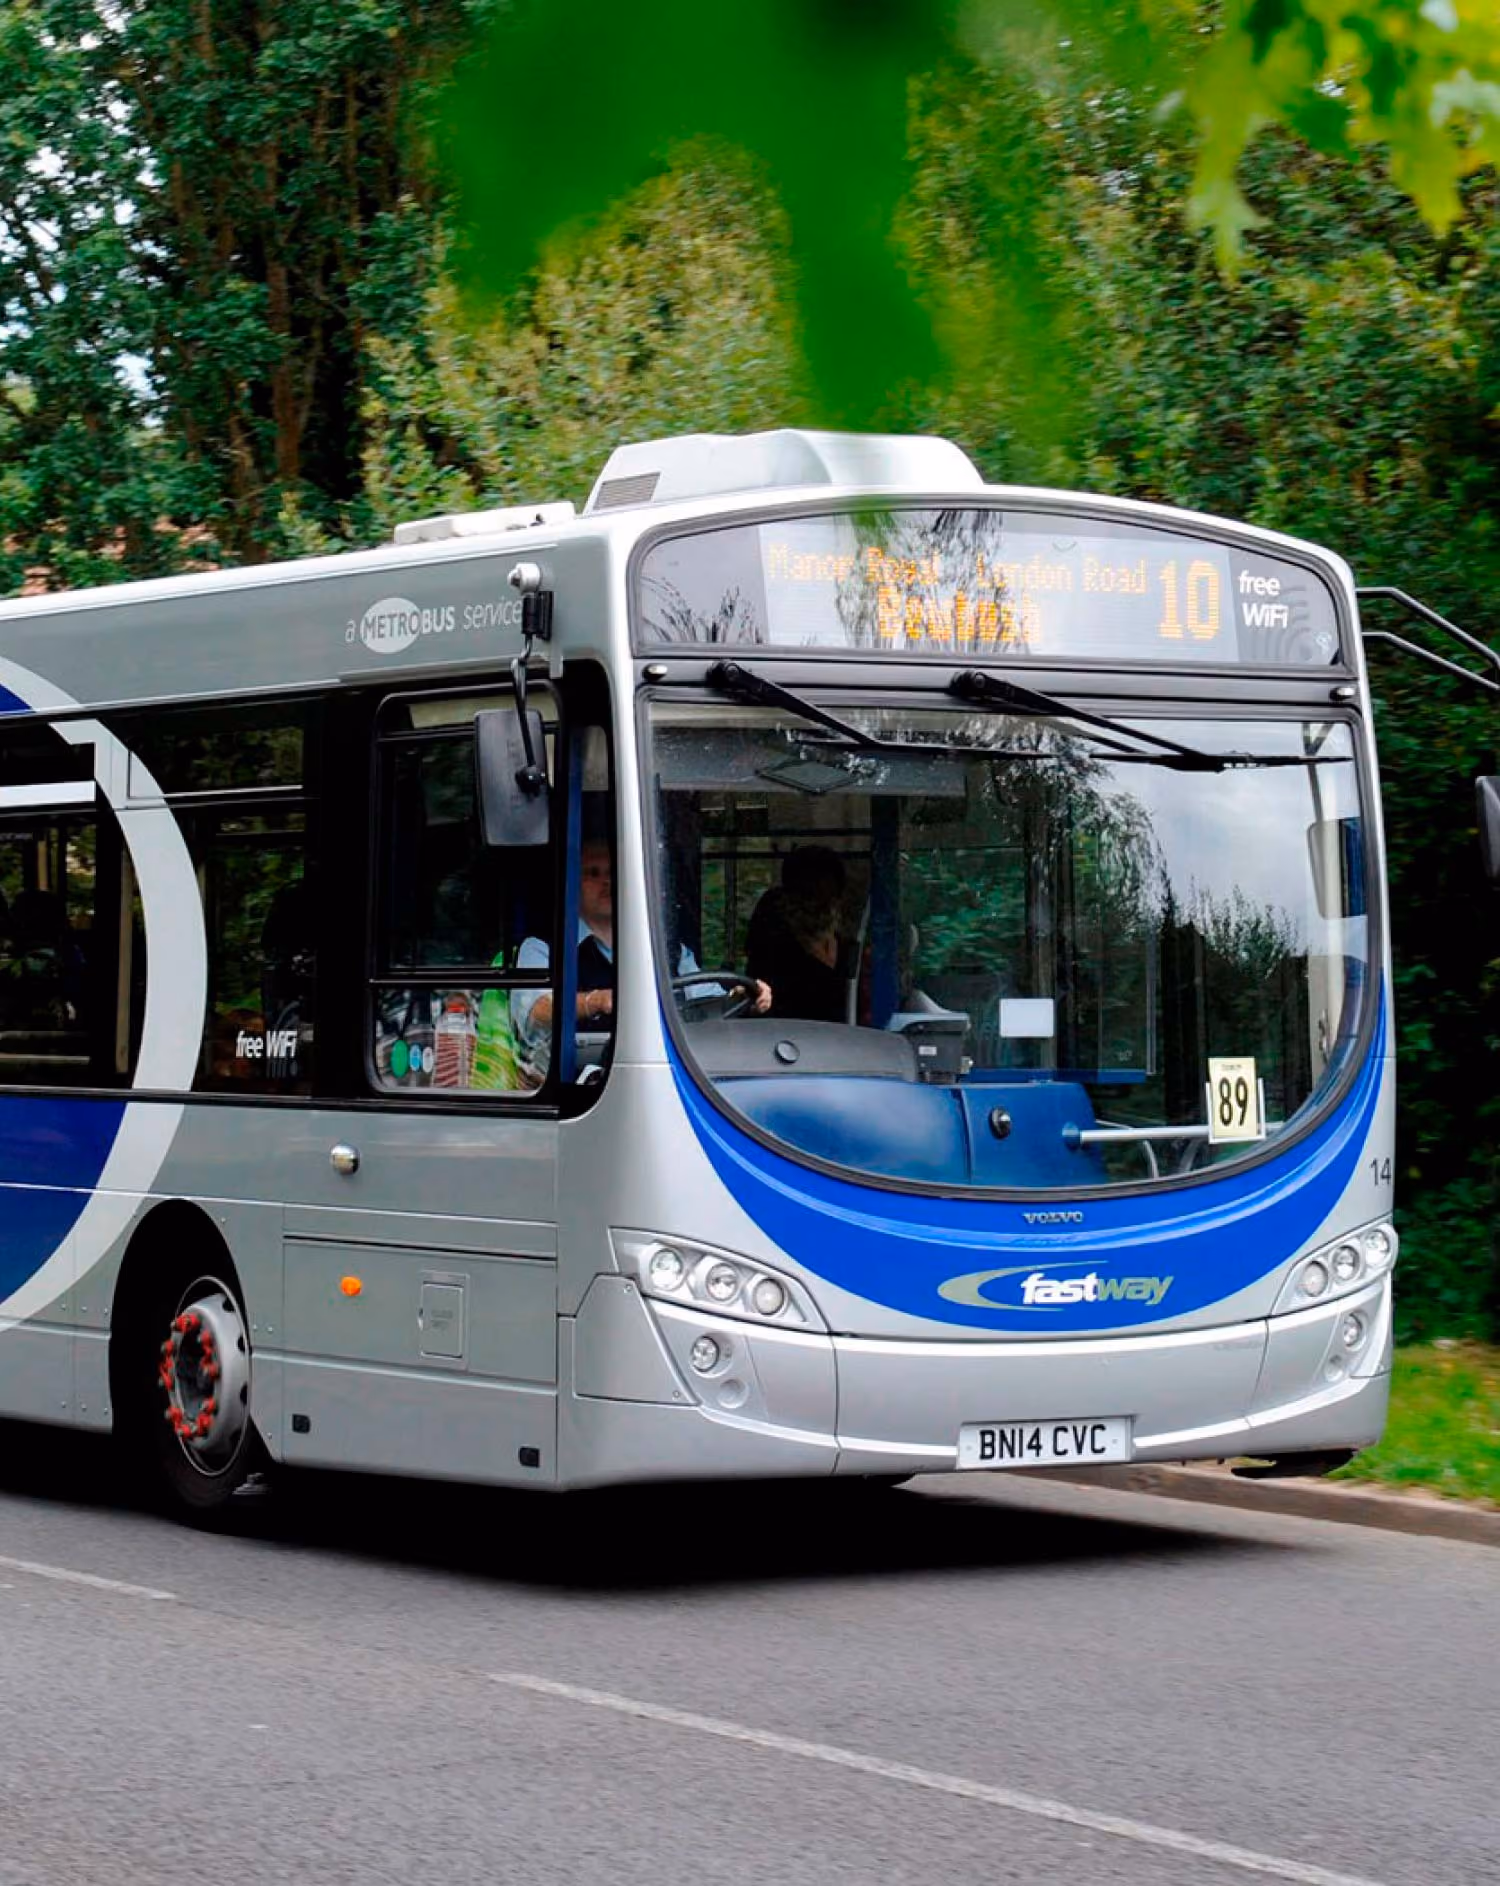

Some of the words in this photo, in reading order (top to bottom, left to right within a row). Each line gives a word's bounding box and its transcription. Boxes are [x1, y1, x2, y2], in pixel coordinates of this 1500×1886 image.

[1083, 556, 1148, 594] Road
[1238, 570, 1281, 596] free
[1157, 559, 1221, 640] 10
[1242, 602, 1289, 629] WiFi
[345, 620, 356, 642] a
[361, 606, 456, 641] METROBUS
[463, 597, 523, 630] service
[235, 1030, 263, 1058] free
[265, 1030, 298, 1058] WiFi
[1219, 1076, 1249, 1127] 89
[1370, 1157, 1391, 1186] 14
[1022, 1210, 1084, 1225] VOLVO
[1020, 1271, 1175, 1306] fastway
[979, 1427, 1042, 1460] BN14
[1053, 1423, 1107, 1456] CVC
